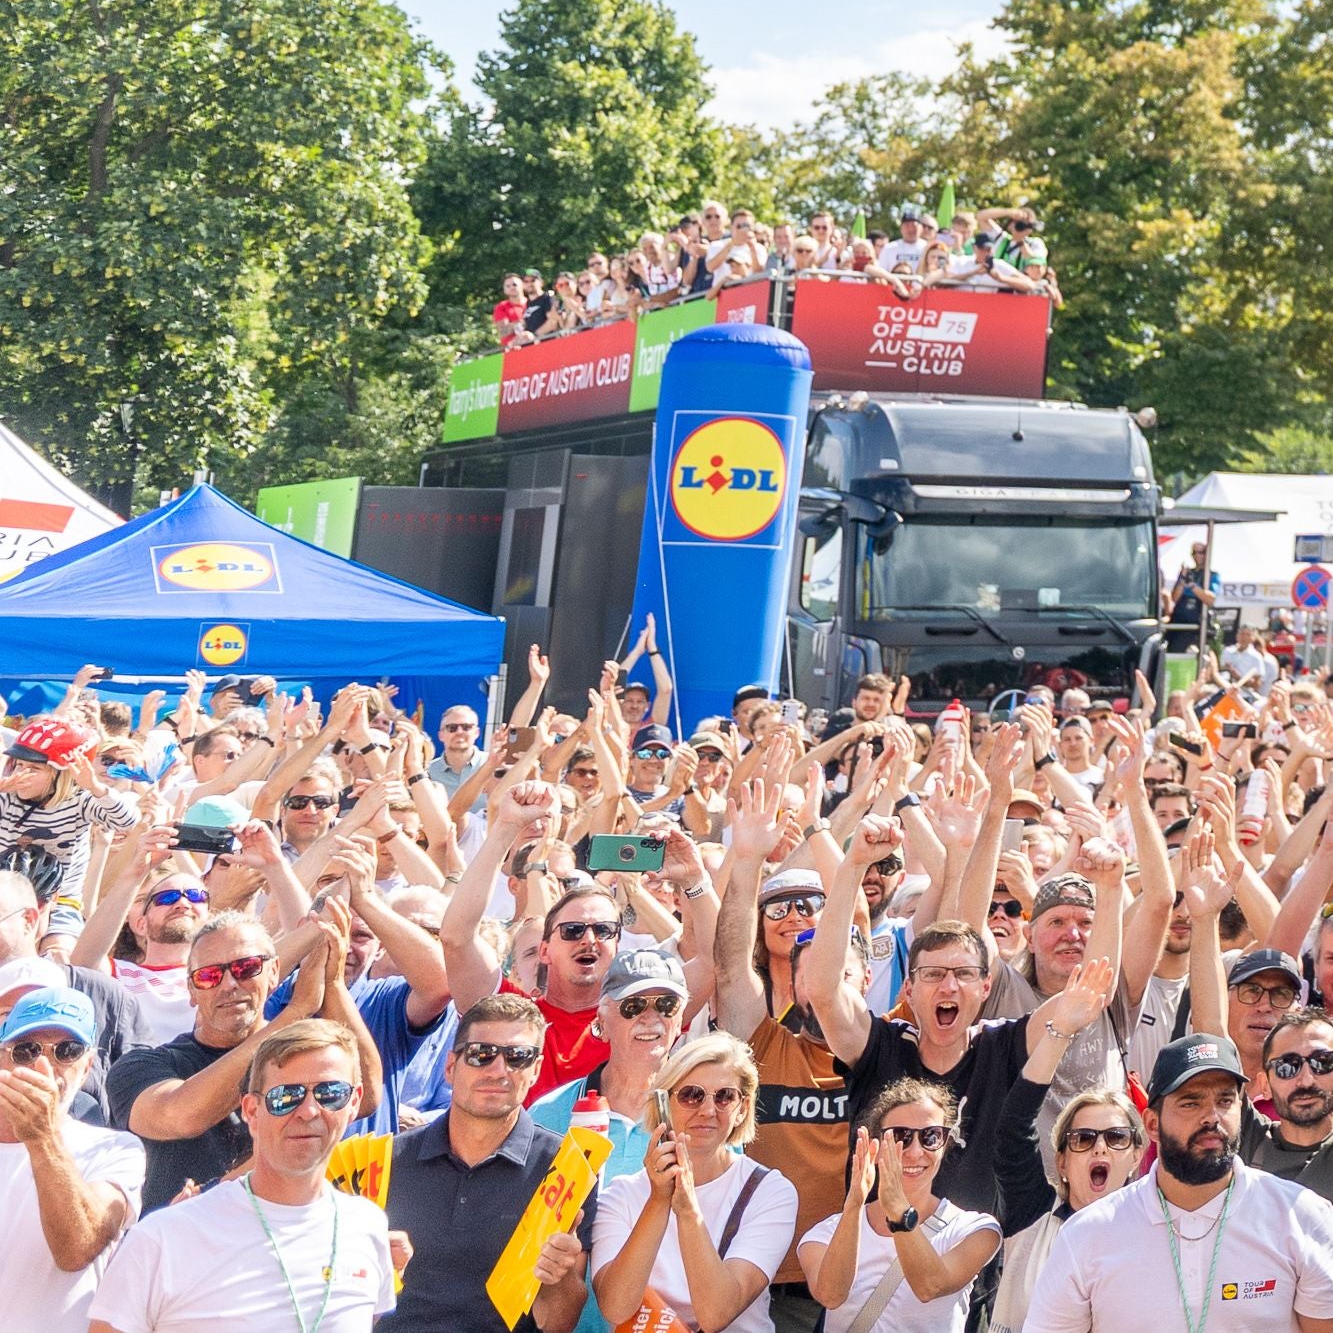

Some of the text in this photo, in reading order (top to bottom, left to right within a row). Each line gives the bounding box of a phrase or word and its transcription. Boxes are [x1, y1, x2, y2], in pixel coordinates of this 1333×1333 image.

[878, 306, 938, 325] TOUR
[872, 322, 904, 338] OF
[946, 320, 967, 335] 75
[869, 340, 966, 359] AUSTRIA
[902, 357, 963, 376] CLUB
[502, 353, 631, 404] TOUR OF AUSTRIA CLUB
[450, 379, 499, 422] harry's home
[780, 1094, 848, 1119] MOLT
